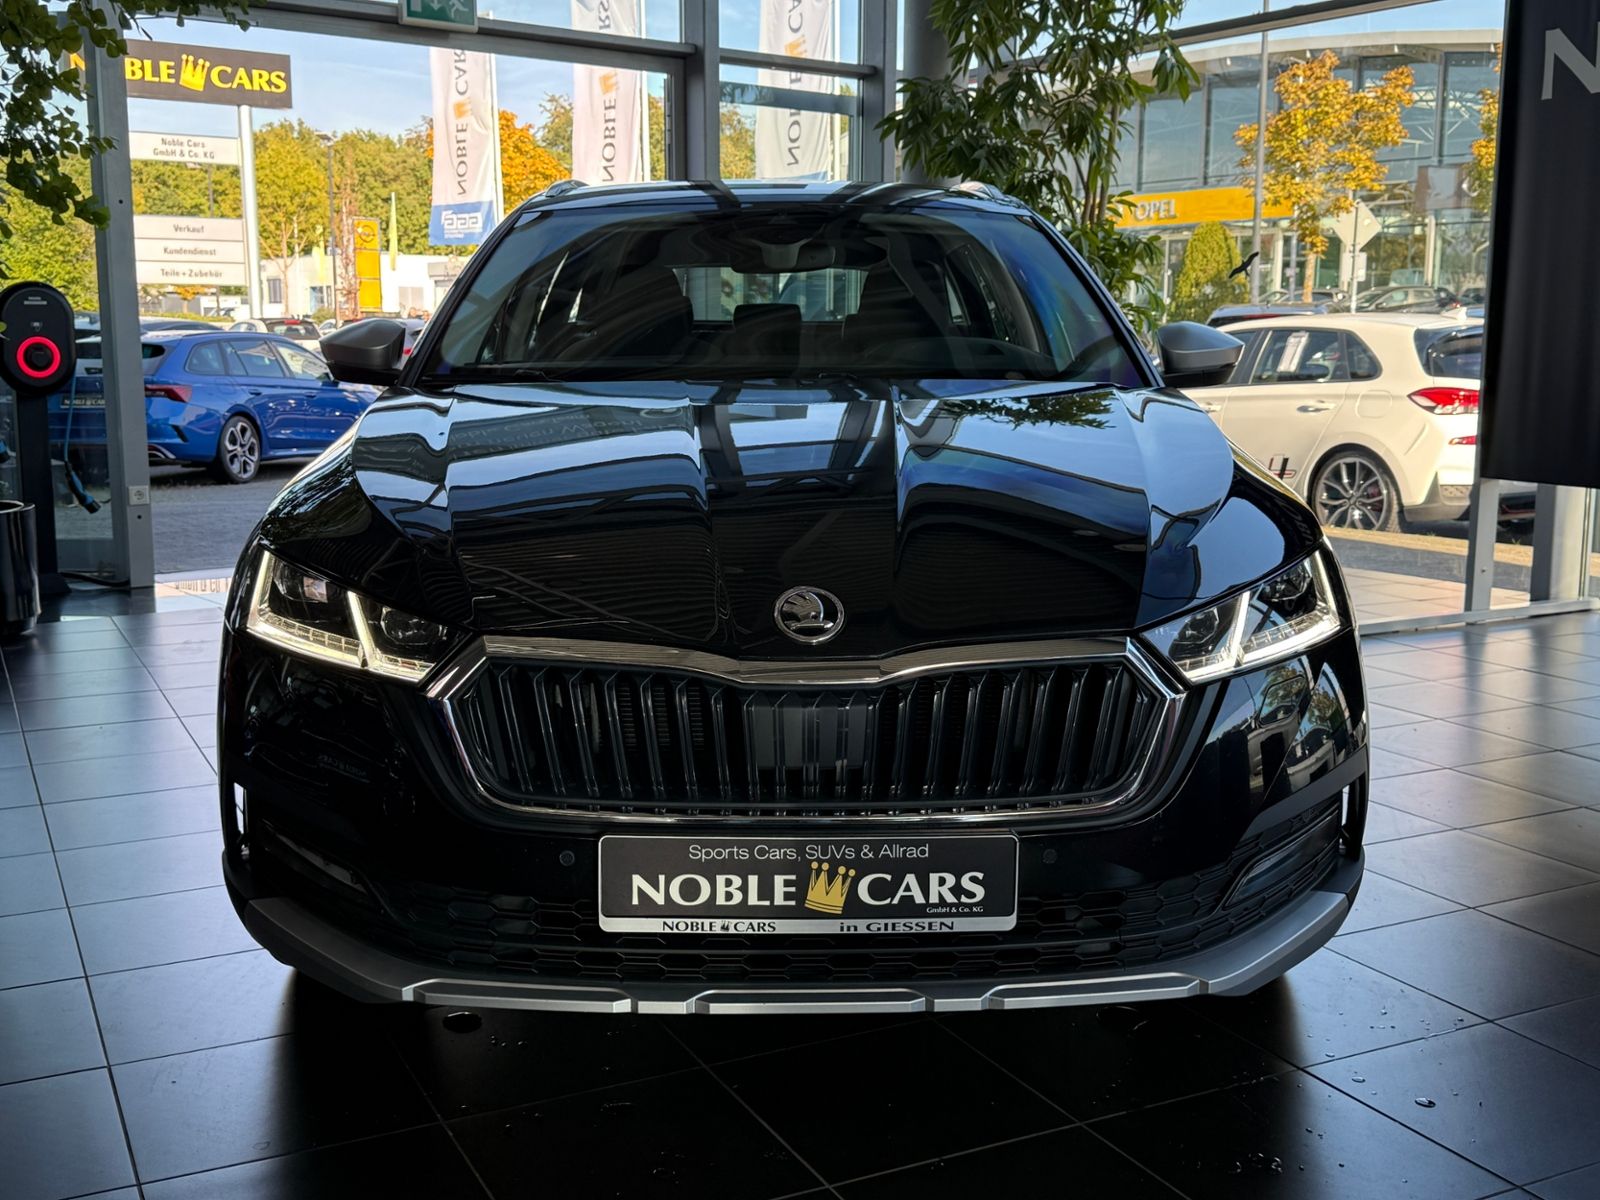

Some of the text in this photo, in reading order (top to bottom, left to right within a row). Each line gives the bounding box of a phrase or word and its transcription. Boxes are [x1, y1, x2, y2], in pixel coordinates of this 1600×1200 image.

[210, 65, 287, 94] CARS
[161, 137, 205, 149] Noble Cars
[153, 148, 176, 157] GmbH
[178, 150, 185, 158] &
[203, 151, 215, 160] KG
[1135, 199, 1177, 221] OPEL
[173, 224, 204, 233] Verkauf
[163, 247, 216, 256] Kundendienst
[689, 843, 930, 862] Sports Cars, SUVs & Allrad
[631, 871, 986, 906] NOBLE CARS
[662, 920, 955, 933] NOBLE CARS in GIESSEN
